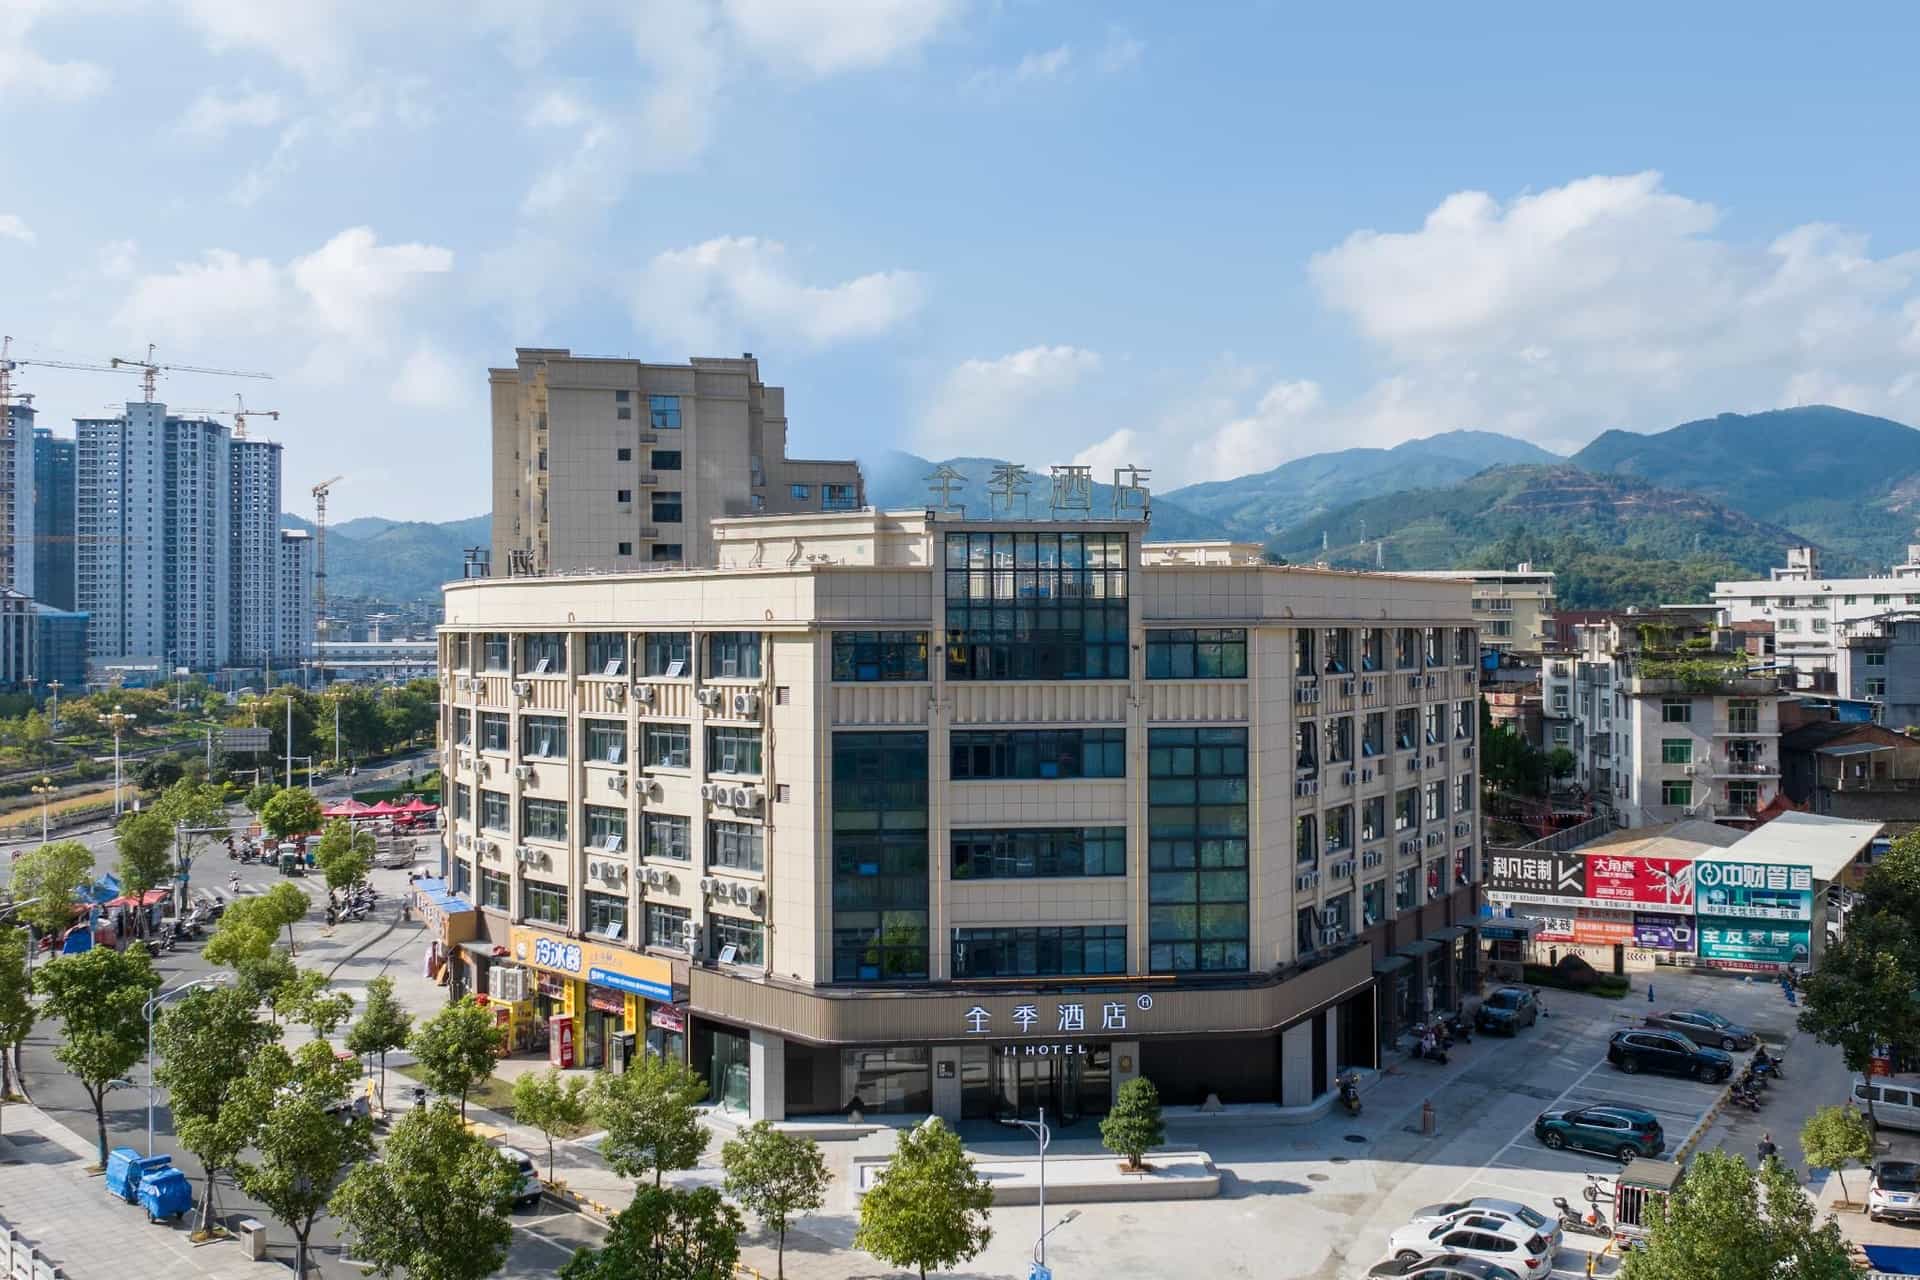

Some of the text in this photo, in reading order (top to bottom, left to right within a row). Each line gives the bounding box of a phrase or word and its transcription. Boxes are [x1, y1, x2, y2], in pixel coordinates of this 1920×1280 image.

[922, 464, 1152, 512] 全季酒店
[1722, 864, 1811, 890] 中财管道
[965, 1002, 1126, 1033] 全季酒店
[1025, 1044, 1087, 1056] HOTEL
